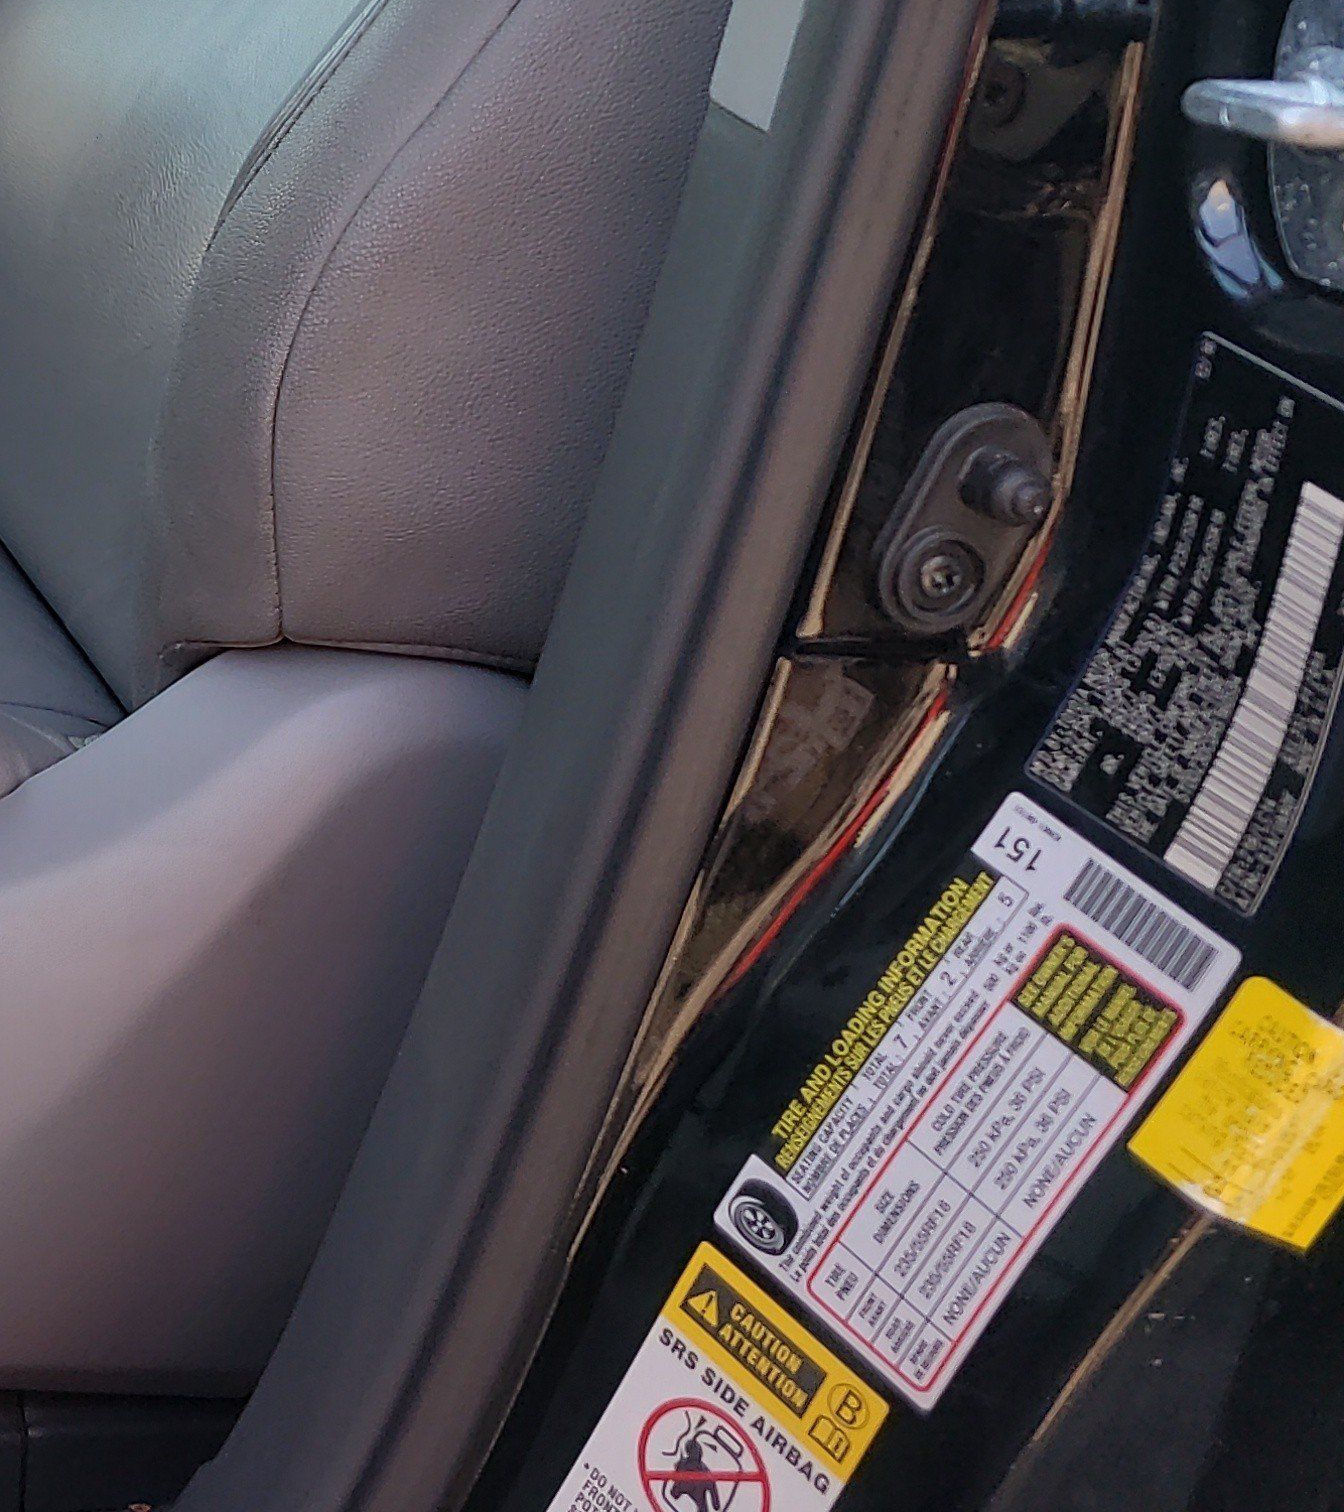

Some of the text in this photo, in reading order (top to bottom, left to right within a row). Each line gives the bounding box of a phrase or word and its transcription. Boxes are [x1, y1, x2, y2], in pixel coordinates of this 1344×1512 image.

[993, 826, 1042, 872] 151
[905, 989, 933, 1021] FRONT
[937, 969, 957, 987] 2
[770, 874, 970, 1141] TIRE AND LOADING INFORMATION
[772, 869, 996, 1169] RENSEIGNEMENTS SUR LES PNEUS ET LE CHARGEMENT
[917, 997, 944, 1030] AVANT
[861, 1050, 888, 1082] TOTAL
[891, 1031, 911, 1049] 7
[872, 1060, 898, 1091] TOTAL
[929, 1028, 1009, 1133] COLD TIRE PRESSURE
[788, 1095, 856, 1184] SEATING CAPACITY
[932, 1110, 970, 1157] PRESSION
[966, 1139, 993, 1168] 250
[1019, 1064, 1047, 1094] PSI
[991, 1159, 1021, 1192] 250
[1045, 1085, 1074, 1116] PSI
[800, 1103, 868, 1194] NOMBRE DE PLACES
[1021, 1110, 1098, 1210] NONE/AUCUN
[870, 1178, 923, 1245] DIMENSIONS
[872, 1189, 895, 1214] SIZE
[823, 1262, 846, 1288] TIRE
[834, 1270, 860, 1301] PNEU
[938, 1229, 1015, 1327] NONE/AUCUN
[716, 1321, 809, 1409] ATTENTION
[727, 1301, 803, 1374] CAUTION
[657, 1326, 833, 1493] SRS SIDE AIRBAG
[835, 1390, 863, 1425] B
[607, 1484, 632, 1512] NOT
